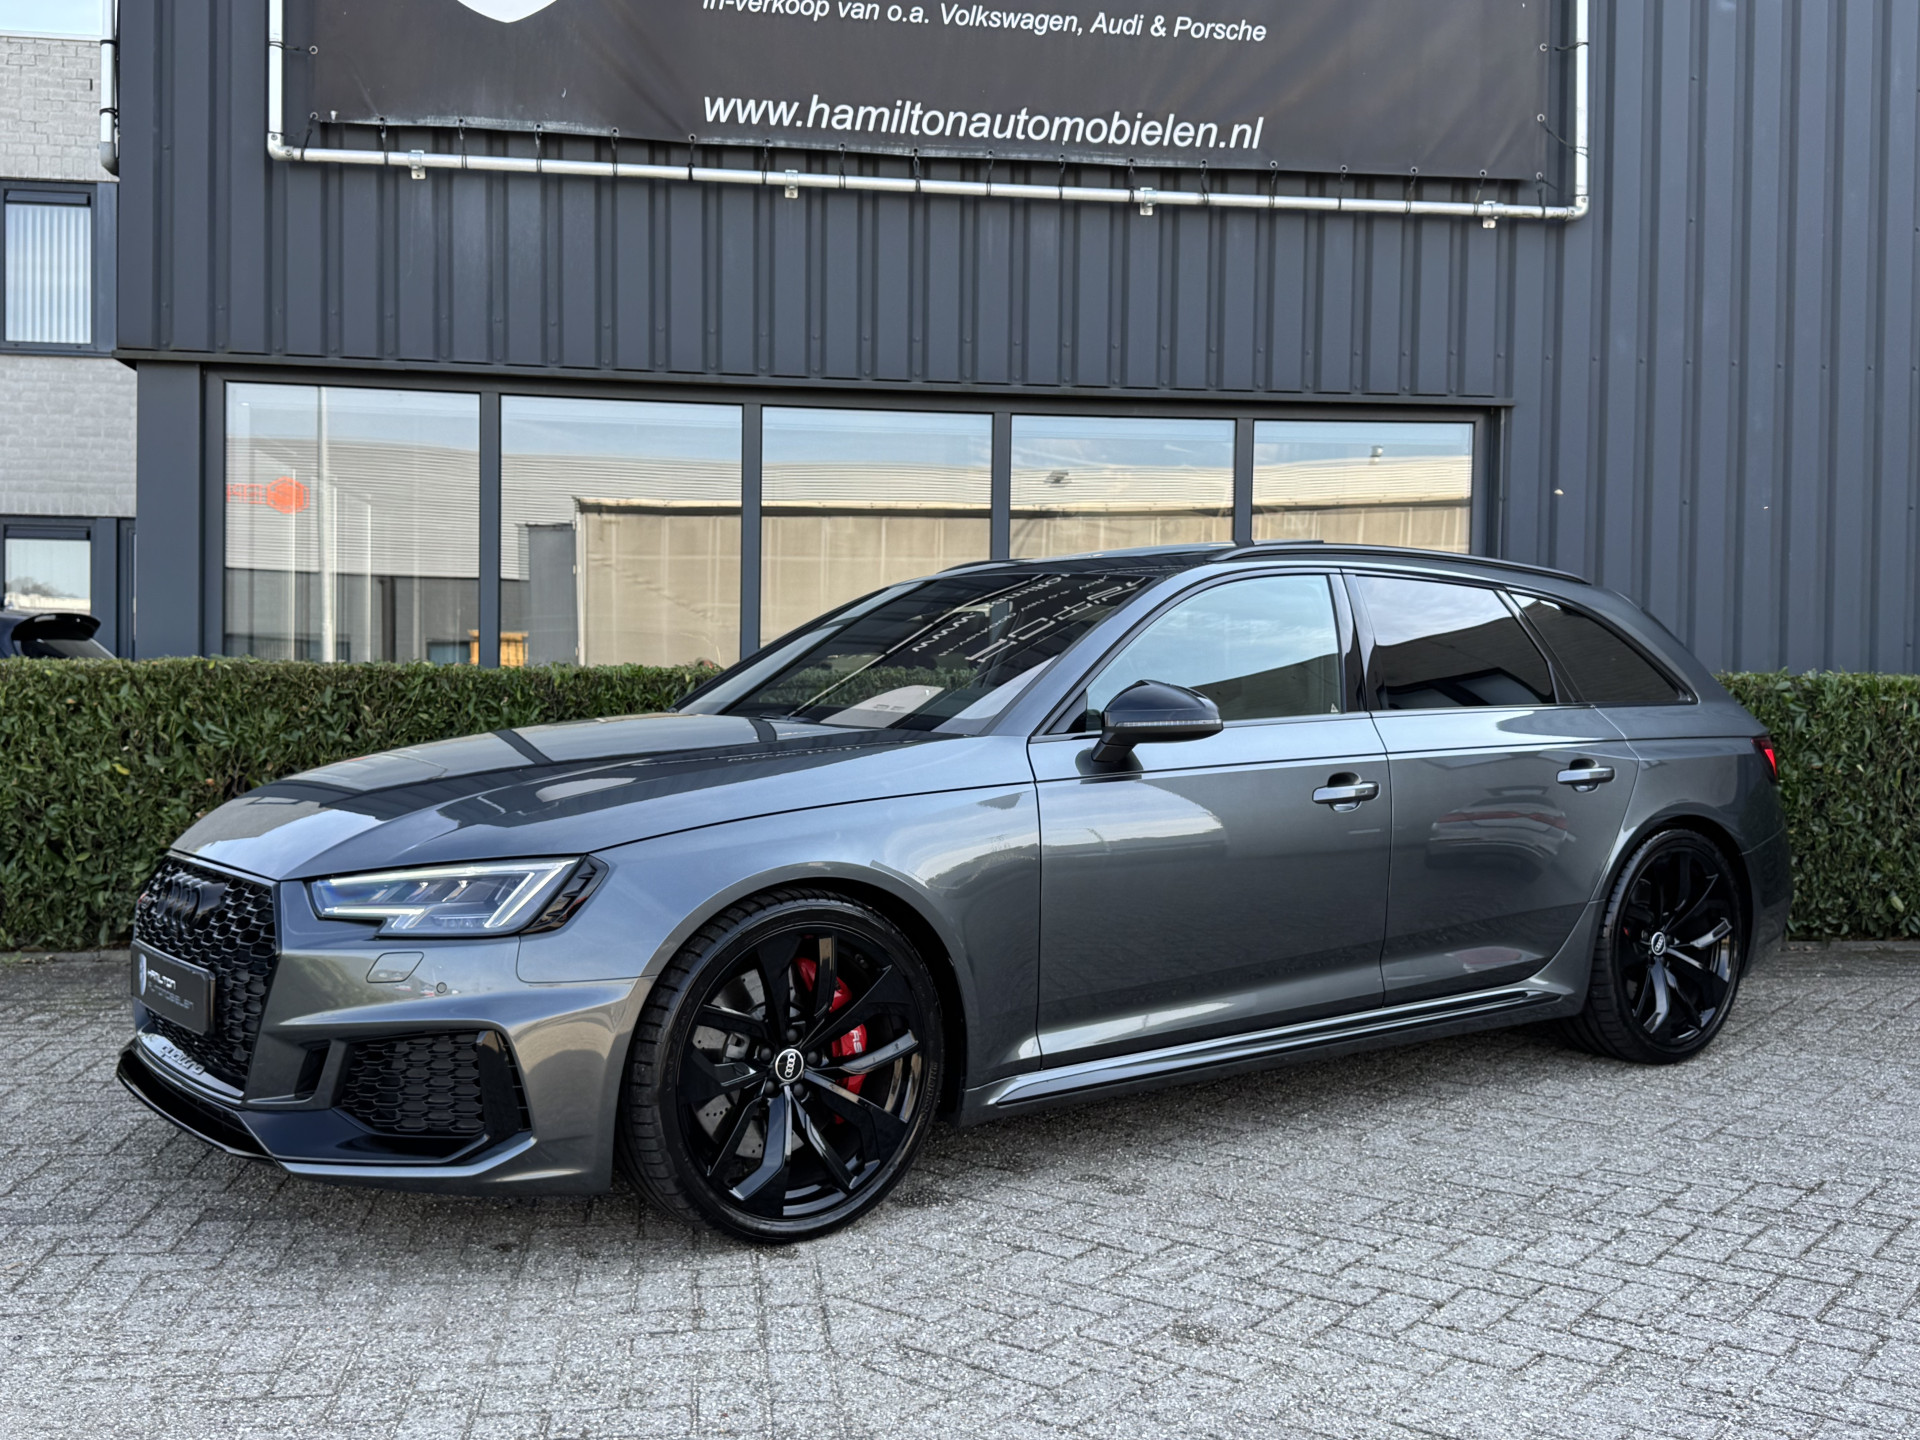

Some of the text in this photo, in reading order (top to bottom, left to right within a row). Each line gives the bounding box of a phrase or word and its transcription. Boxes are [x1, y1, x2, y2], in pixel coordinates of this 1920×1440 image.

[838, 1, 880, 21] van
[887, 5, 929, 24] o.a.
[940, 3, 1083, 36] Volkswagen,
[1089, 12, 1145, 37] Audi
[1150, 14, 1168, 38] &
[1173, 16, 1267, 42] Porsche
[704, 96, 1265, 150] www.hamiltonautomobielen.nl
[850, 1029, 863, 1053] RS
